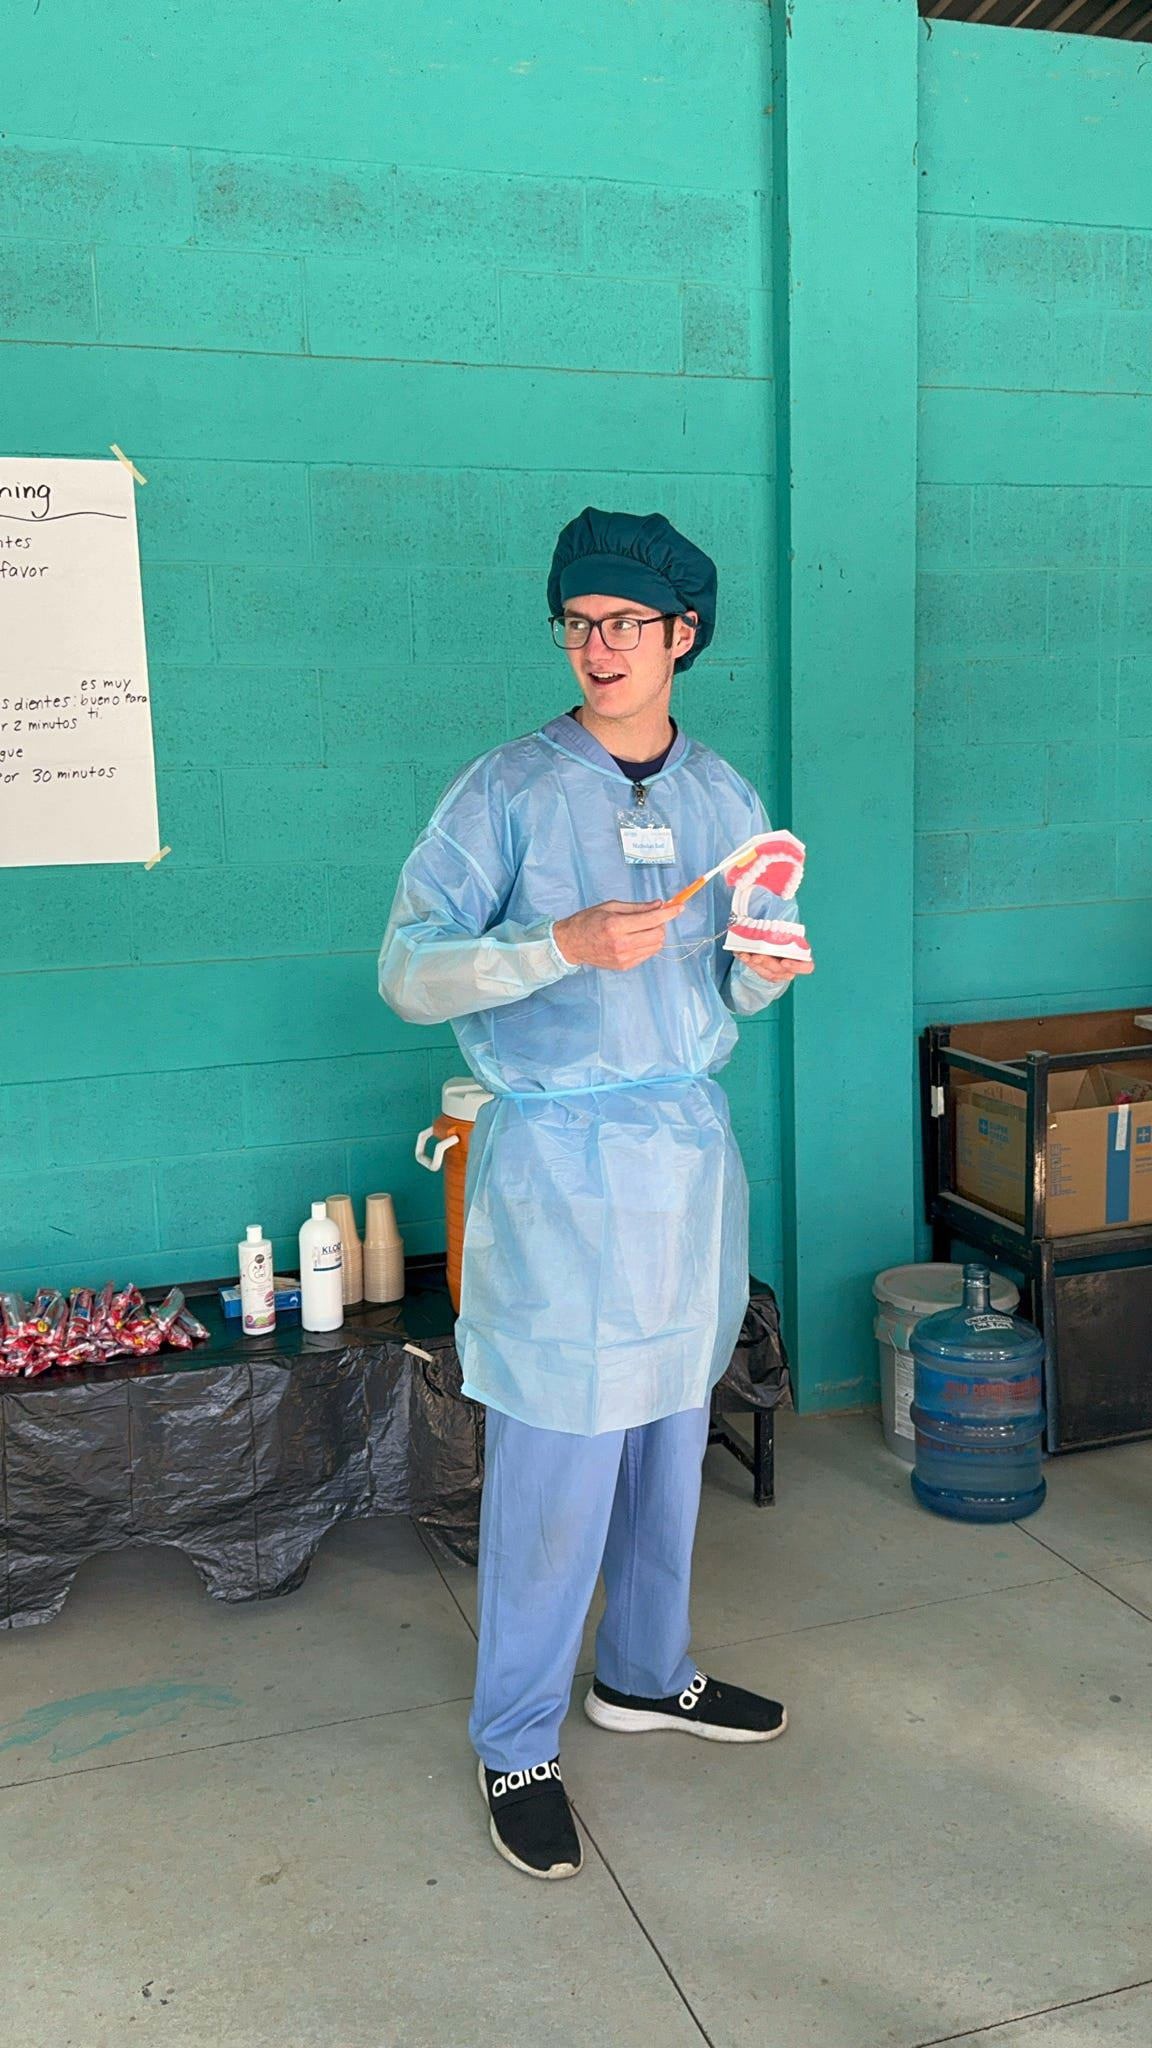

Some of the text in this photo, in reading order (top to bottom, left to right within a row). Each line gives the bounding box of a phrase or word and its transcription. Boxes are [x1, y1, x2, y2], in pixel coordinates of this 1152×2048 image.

[0, 560, 49, 578] favor
[80, 678, 132, 692] es muy
[80, 694, 120, 706] bueno
[14, 720, 22, 732] 2
[28, 717, 78, 732] minutos
[0, 766, 117, 784] or 30 minutos
